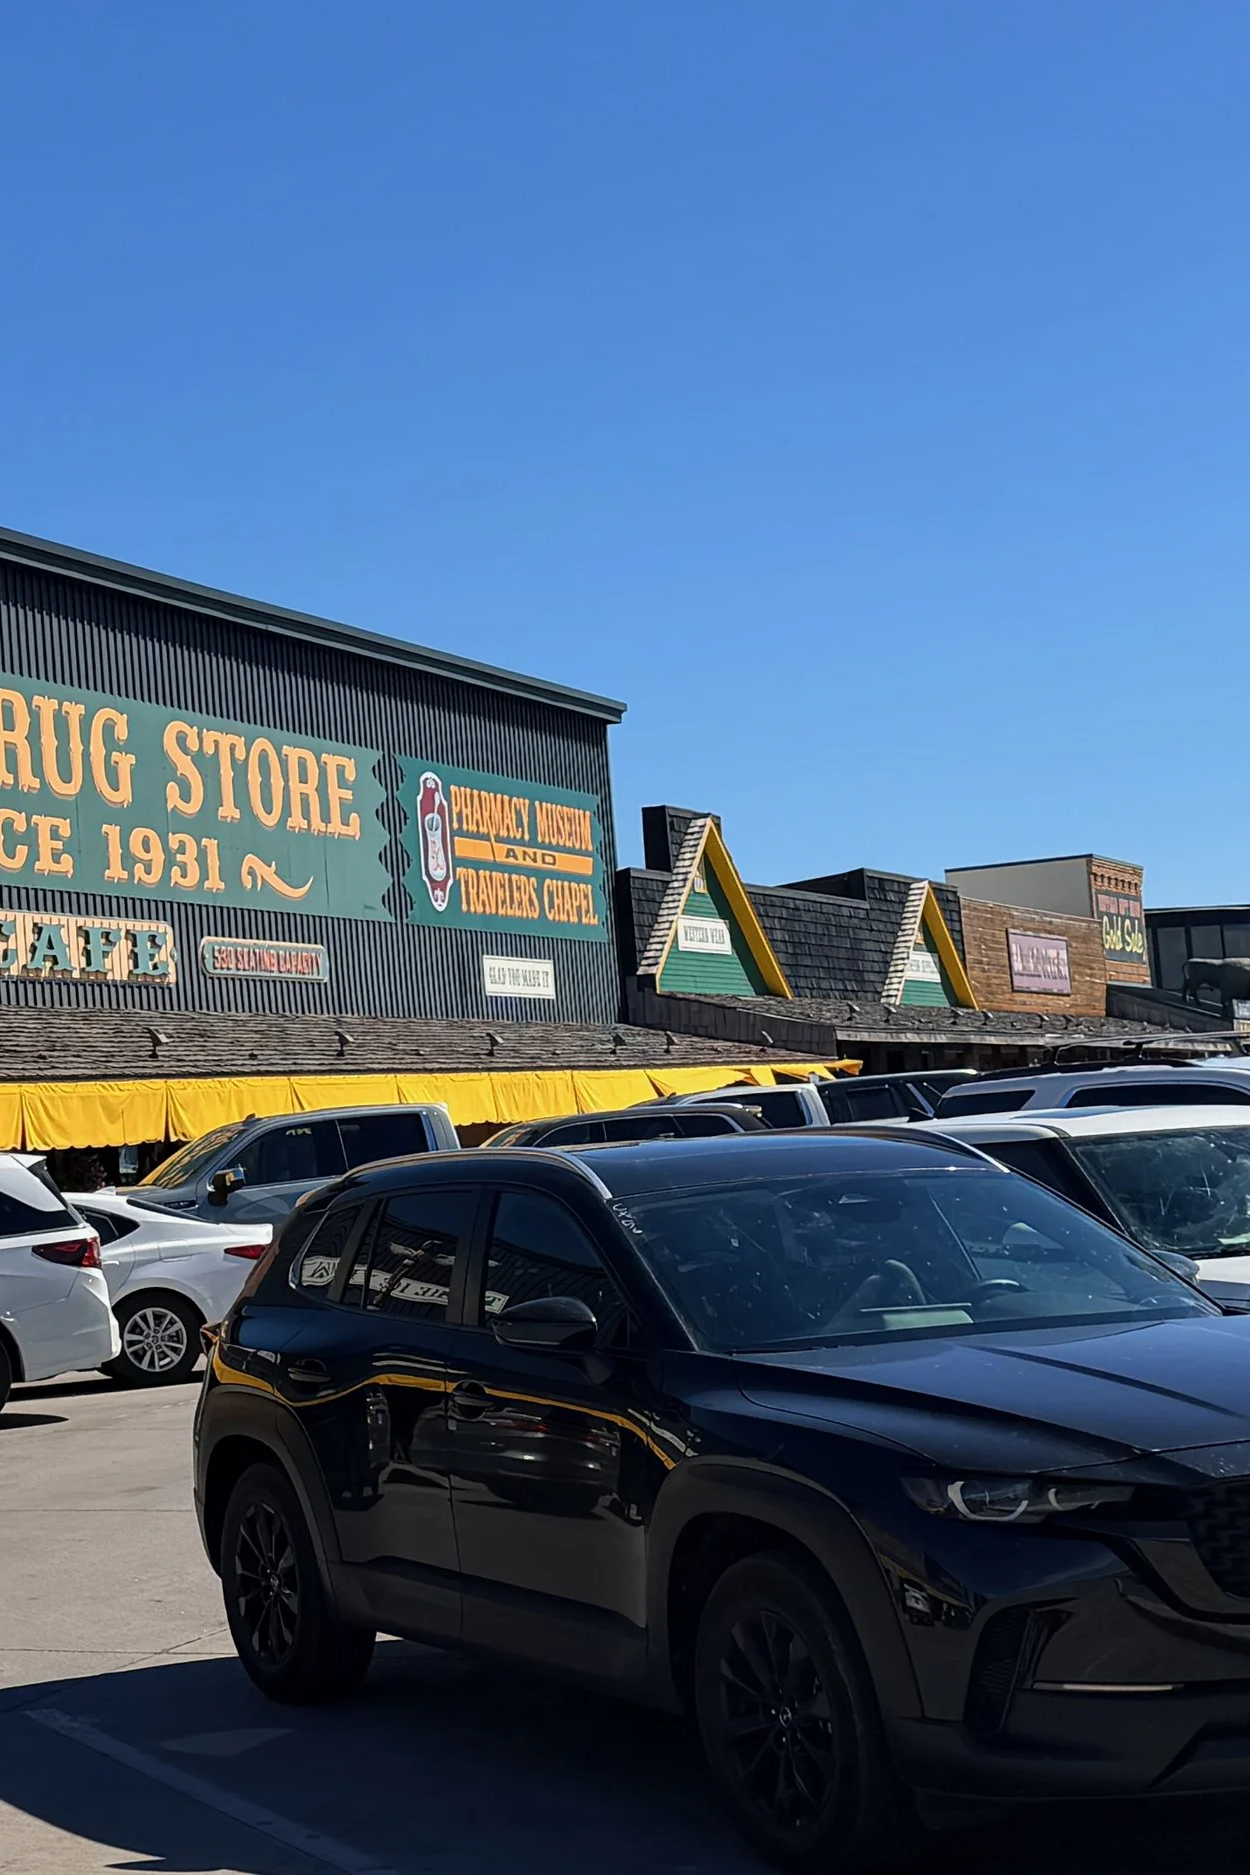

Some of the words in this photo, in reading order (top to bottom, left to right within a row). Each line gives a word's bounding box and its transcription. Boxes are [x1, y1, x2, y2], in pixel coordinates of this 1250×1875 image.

[164, 719, 361, 841] STORE
[450, 784, 530, 842] PHARMACY
[534, 800, 593, 852] MUSEUM
[102, 823, 226, 893] 1931
[504, 847, 558, 867] AND
[456, 866, 540, 920] TRAVELERS
[543, 877, 599, 926] CHAPEL
[237, 946, 277, 972] SEATING
[279, 949, 323, 976] CAPACITY
